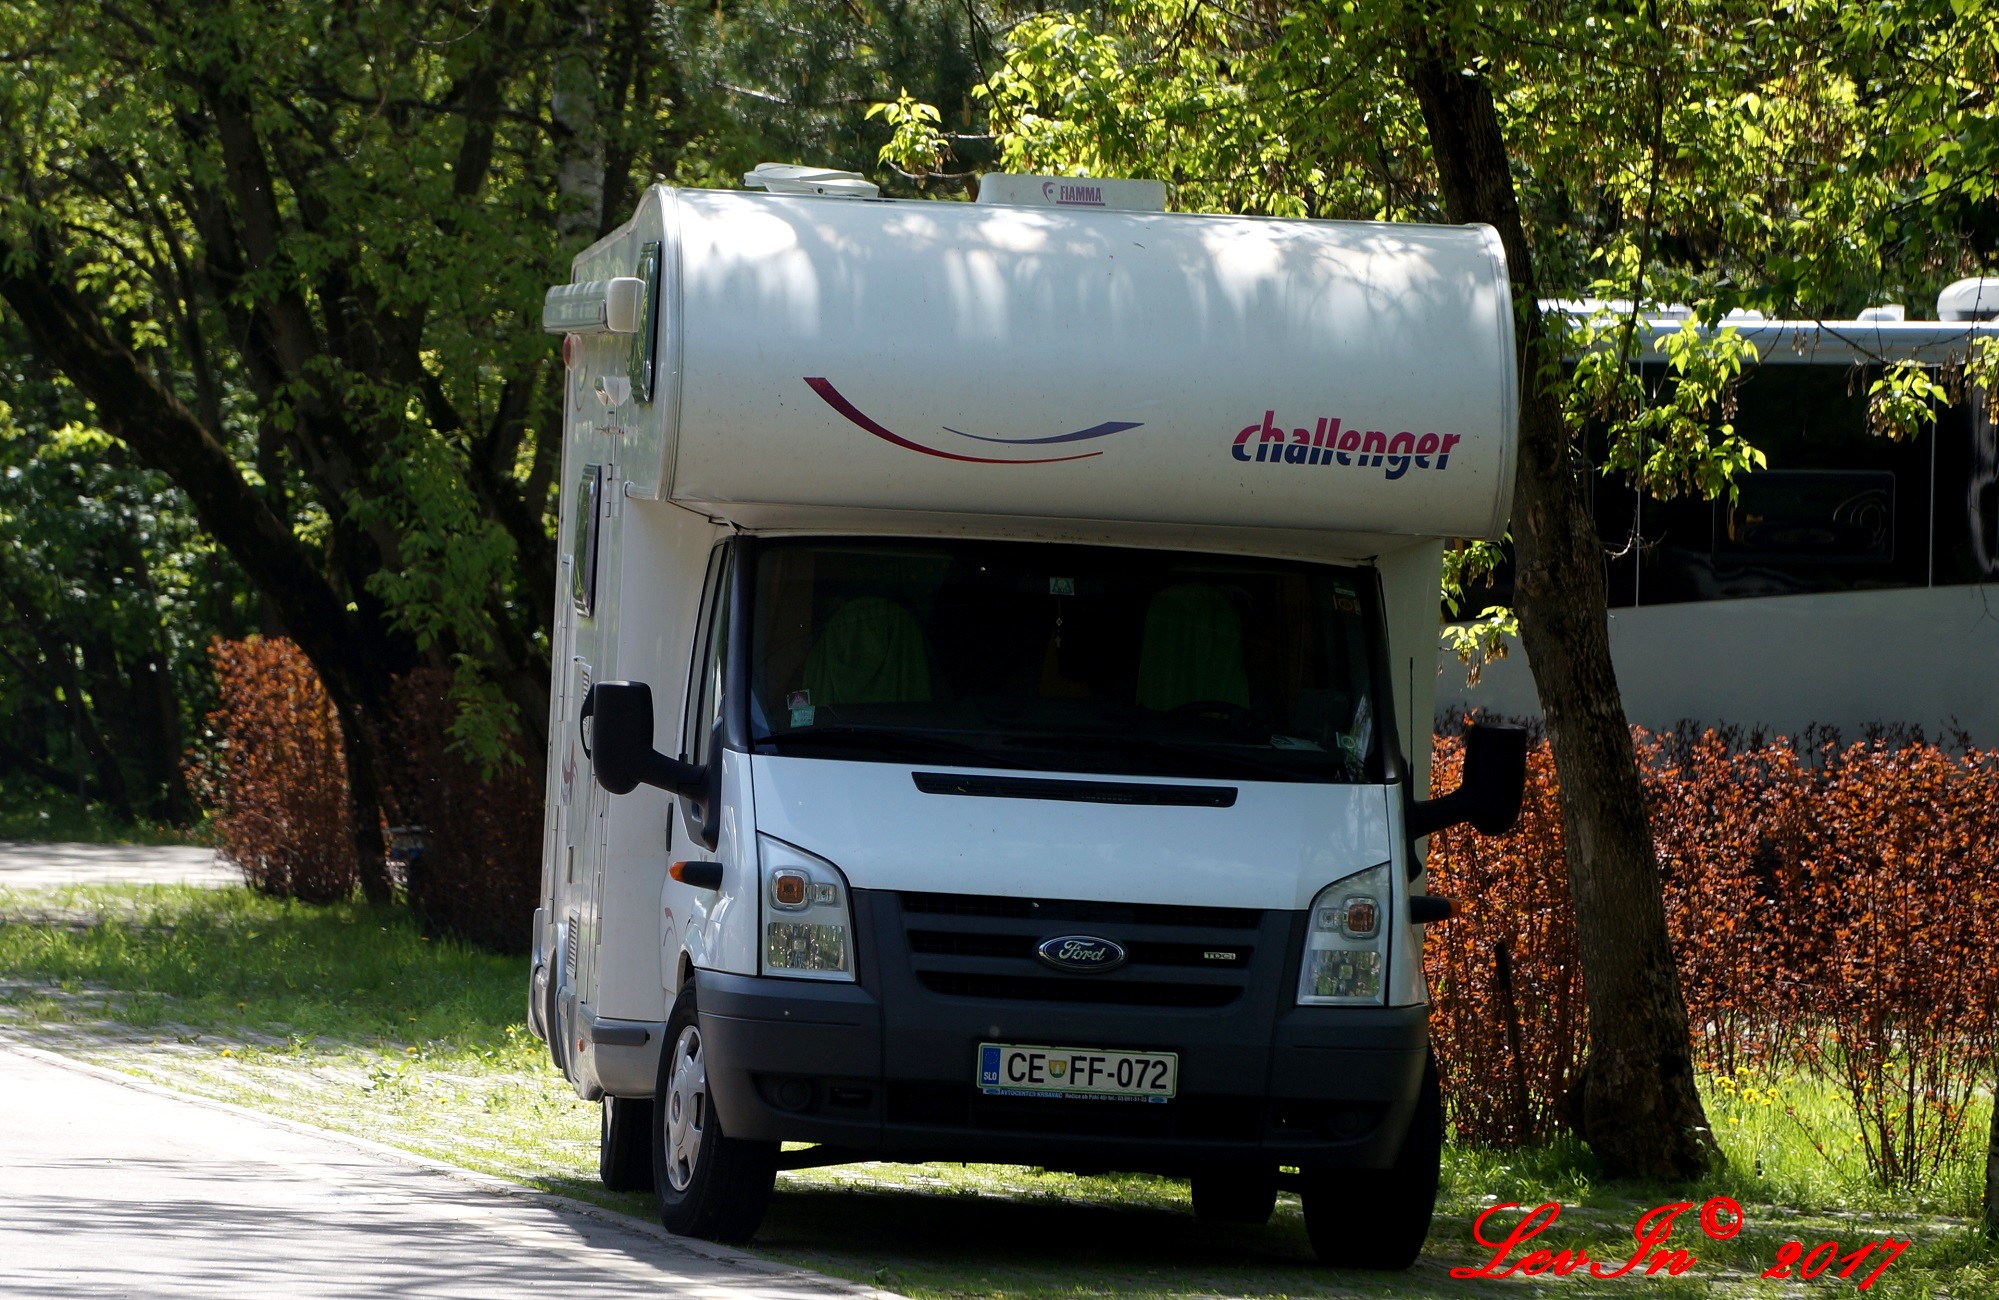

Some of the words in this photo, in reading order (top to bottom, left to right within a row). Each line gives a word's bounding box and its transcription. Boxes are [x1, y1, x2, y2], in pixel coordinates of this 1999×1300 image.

[1060, 186, 1102, 202] FIAMMA
[1231, 410, 1461, 480] challenger
[1058, 940, 1106, 961] Ford
[983, 1071, 997, 1081] SLO
[1007, 1052, 1046, 1084] CE
[1069, 1055, 1168, 1090] FF-072
